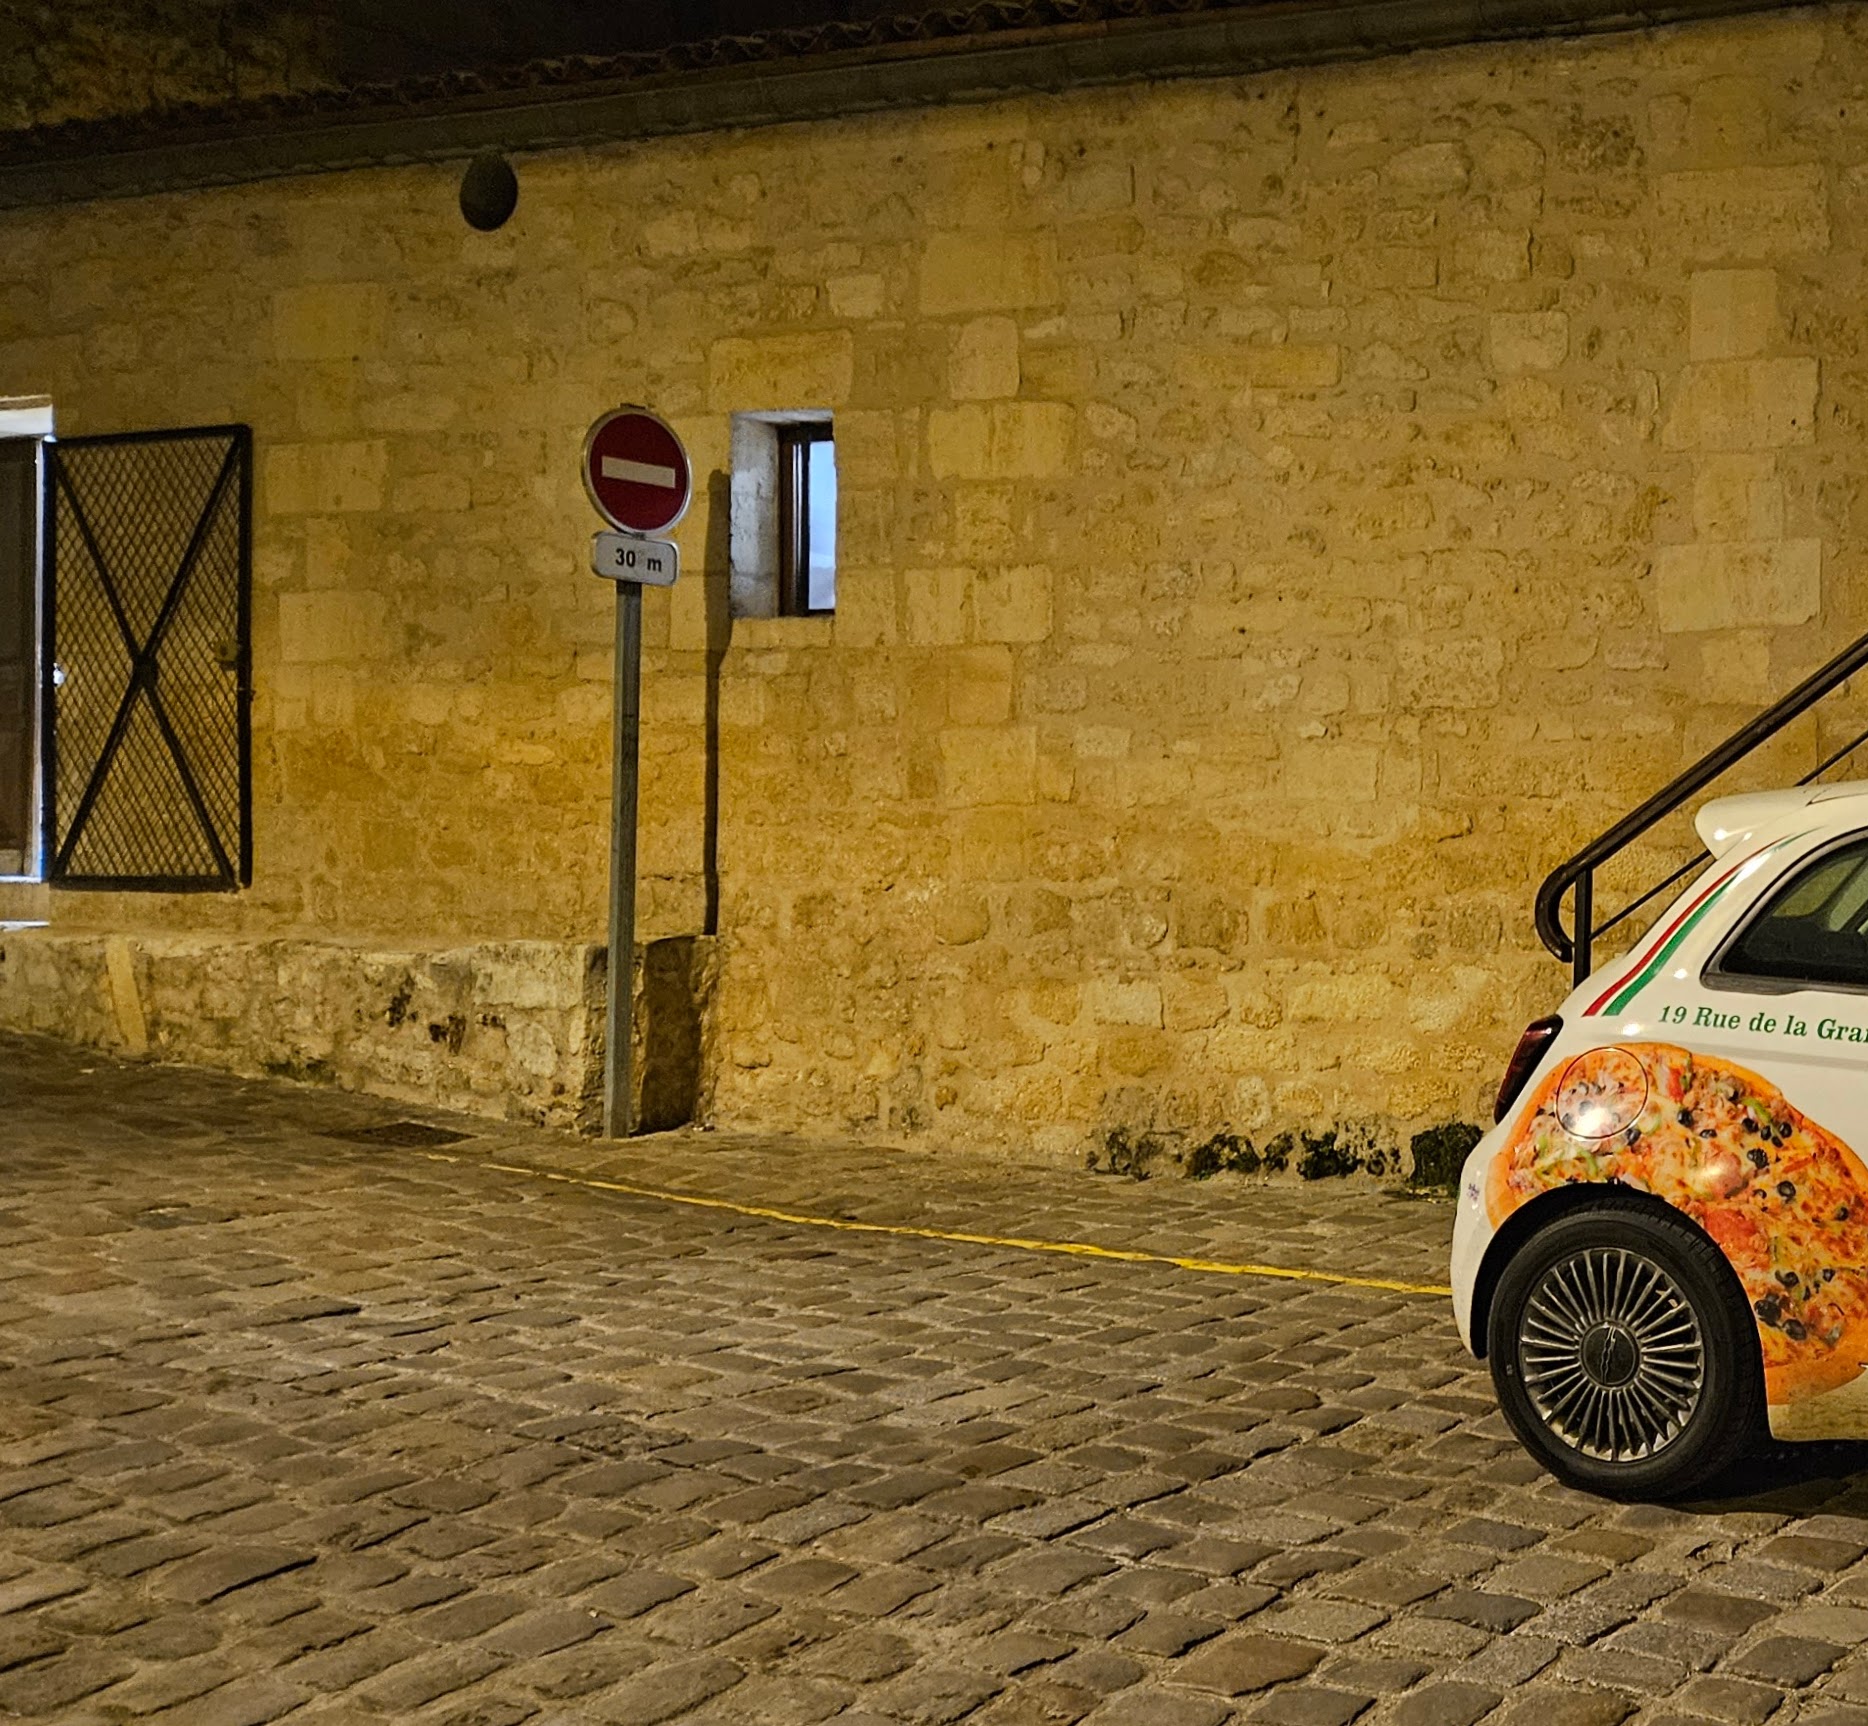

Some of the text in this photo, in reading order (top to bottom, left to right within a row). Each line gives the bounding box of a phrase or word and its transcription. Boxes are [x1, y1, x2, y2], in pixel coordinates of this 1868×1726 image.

[615, 548, 662, 572] 30 m
[1659, 1004, 1688, 1026] 19
[1692, 1007, 1741, 1034] Rue
[1747, 1010, 1779, 1035] de
[1783, 1013, 1810, 1037] la
